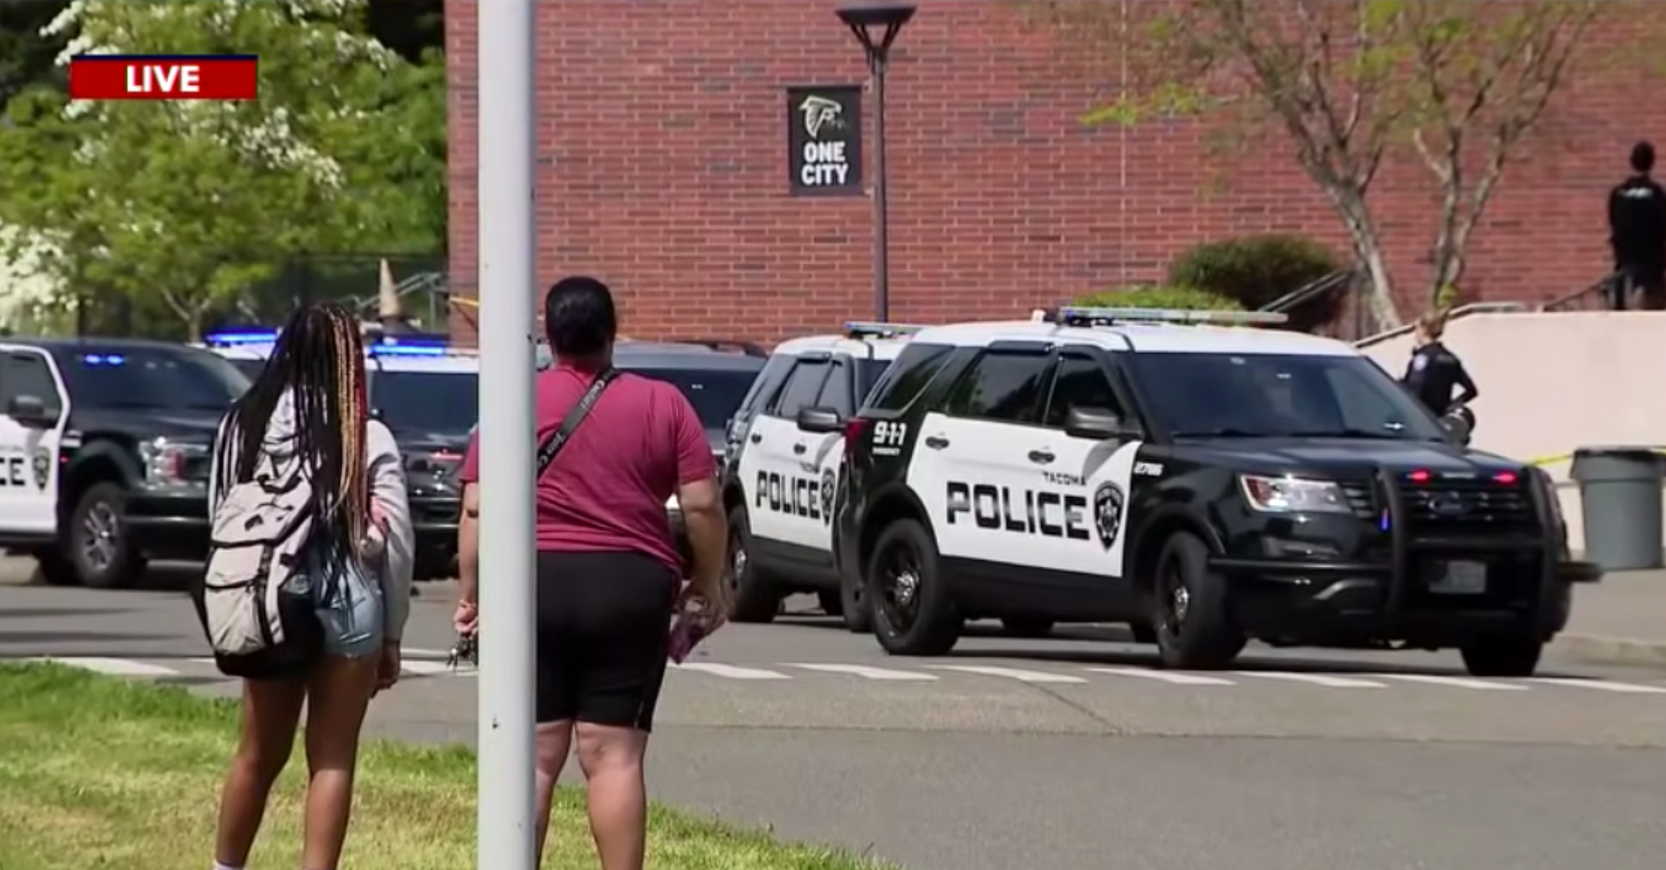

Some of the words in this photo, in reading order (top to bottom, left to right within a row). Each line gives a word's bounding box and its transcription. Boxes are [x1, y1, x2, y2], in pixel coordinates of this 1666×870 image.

[804, 141, 846, 162] ONE
[801, 163, 849, 185] CITY
[1042, 471, 1087, 486] TACOMA
[755, 470, 820, 519] POLICE
[946, 480, 1091, 541] POLICE
